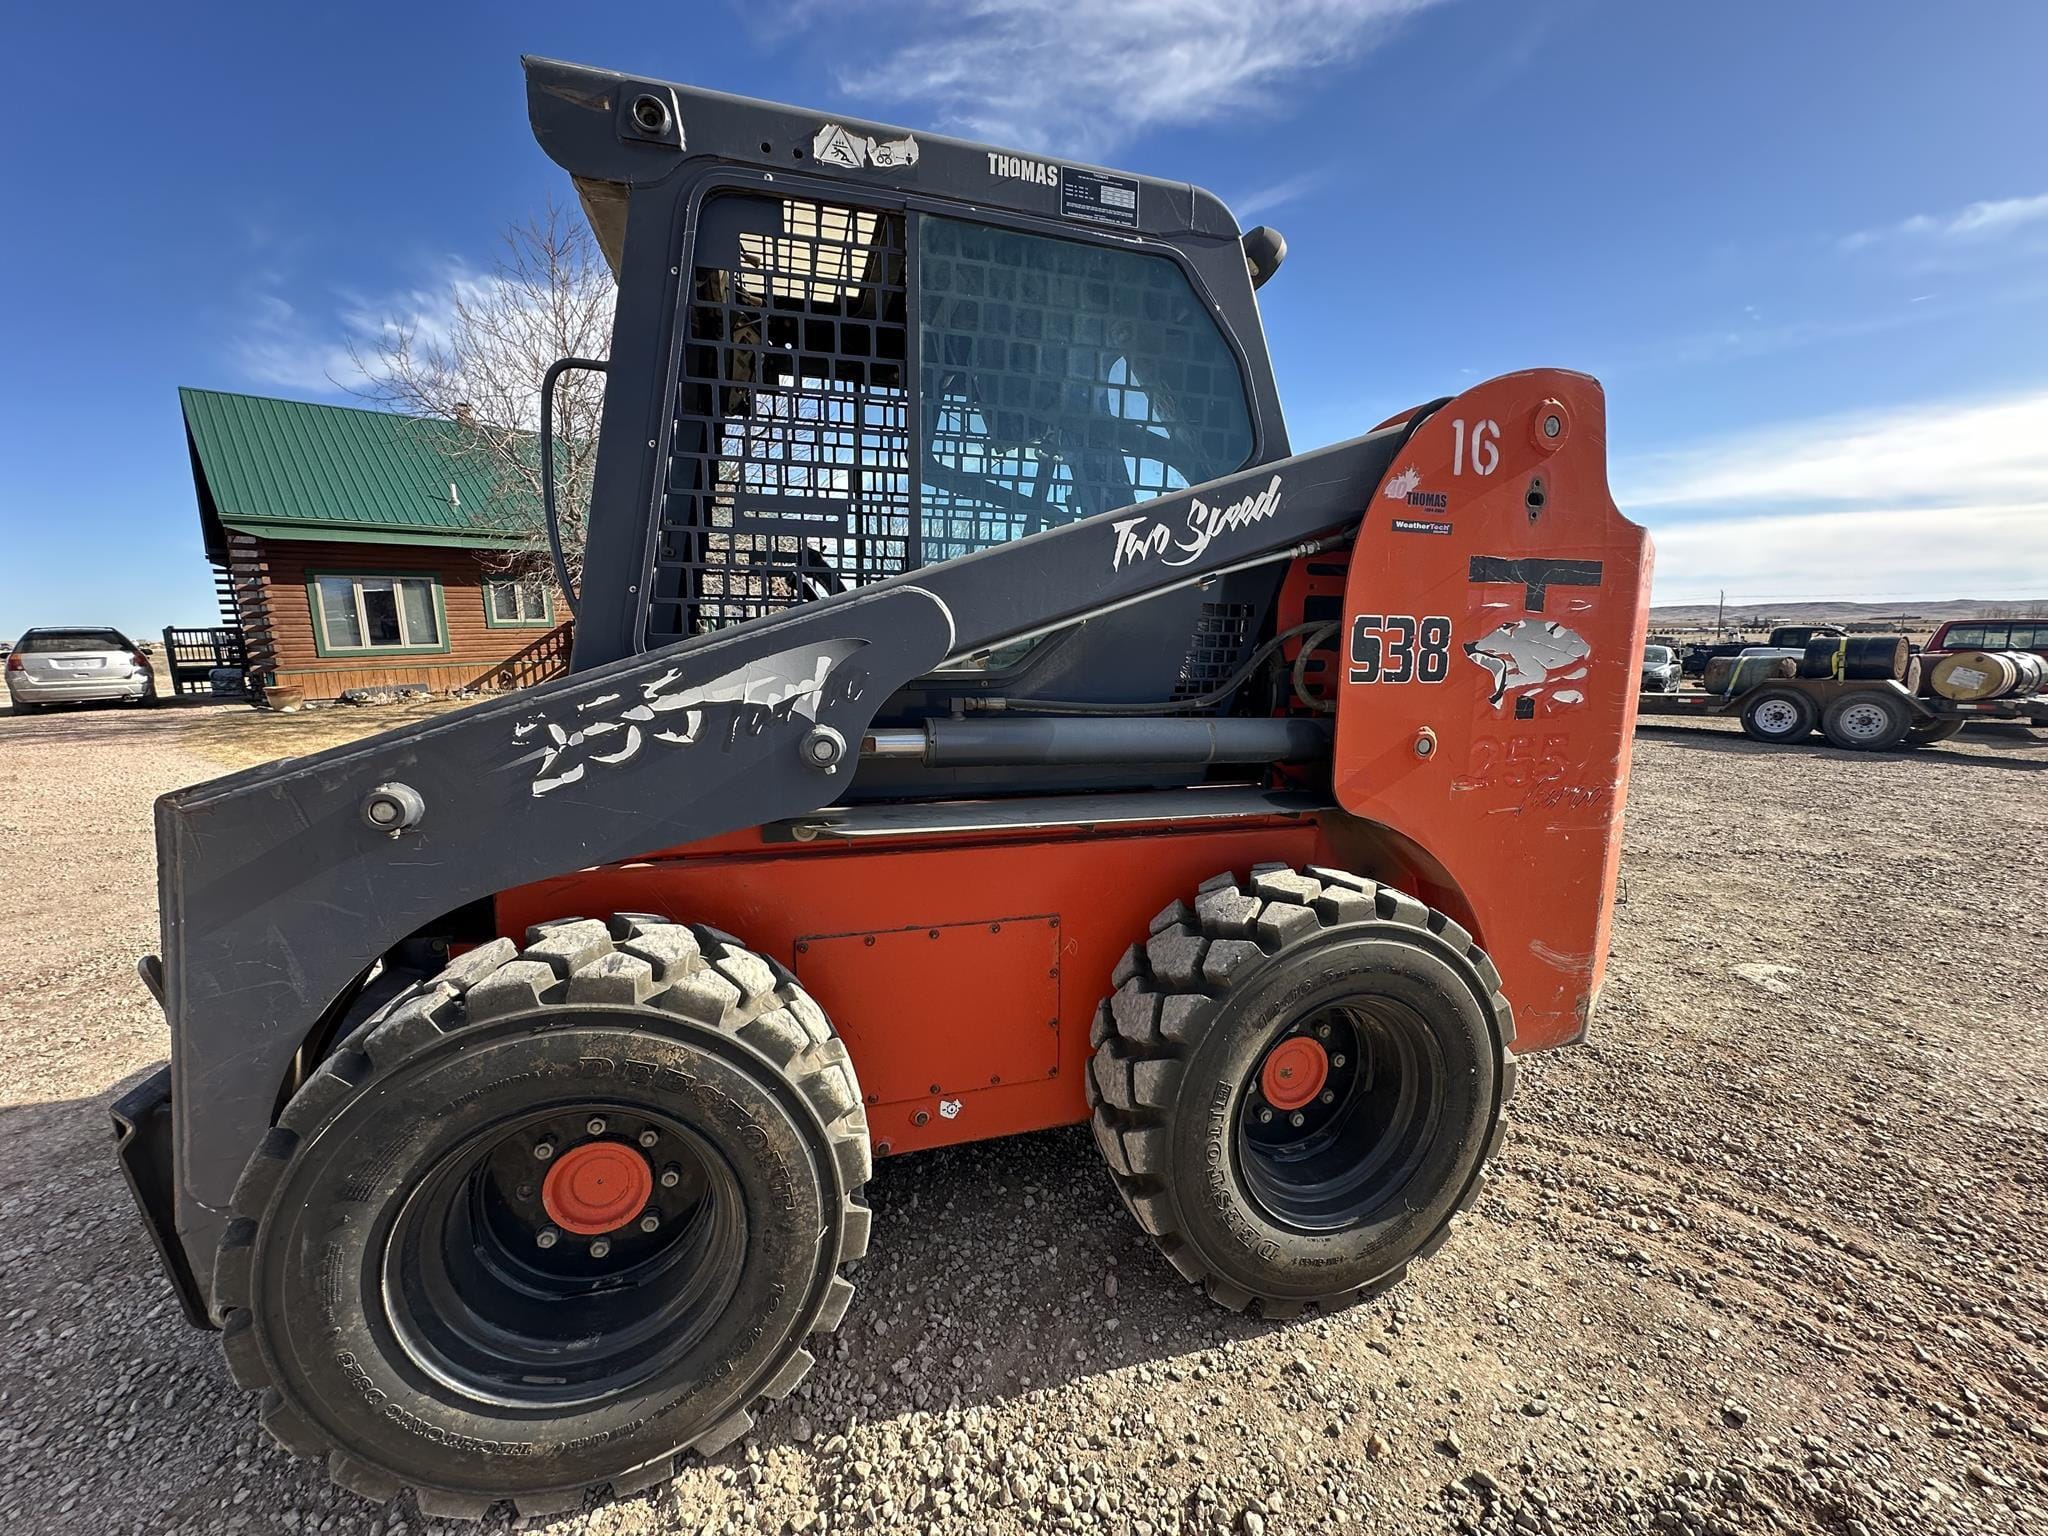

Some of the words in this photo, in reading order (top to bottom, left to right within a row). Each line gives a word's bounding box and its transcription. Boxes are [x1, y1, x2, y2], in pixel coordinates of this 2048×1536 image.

[987, 152, 1058, 187] THOMAS
[1452, 419, 1500, 476] 16
[1112, 516, 1170, 572] Two
[1161, 475, 1282, 567] Speed
[1407, 491, 1447, 508] THOMAS
[1205, 1079, 1281, 1262] DEESTONE
[383, 1402, 533, 1456] TECHTONIC
